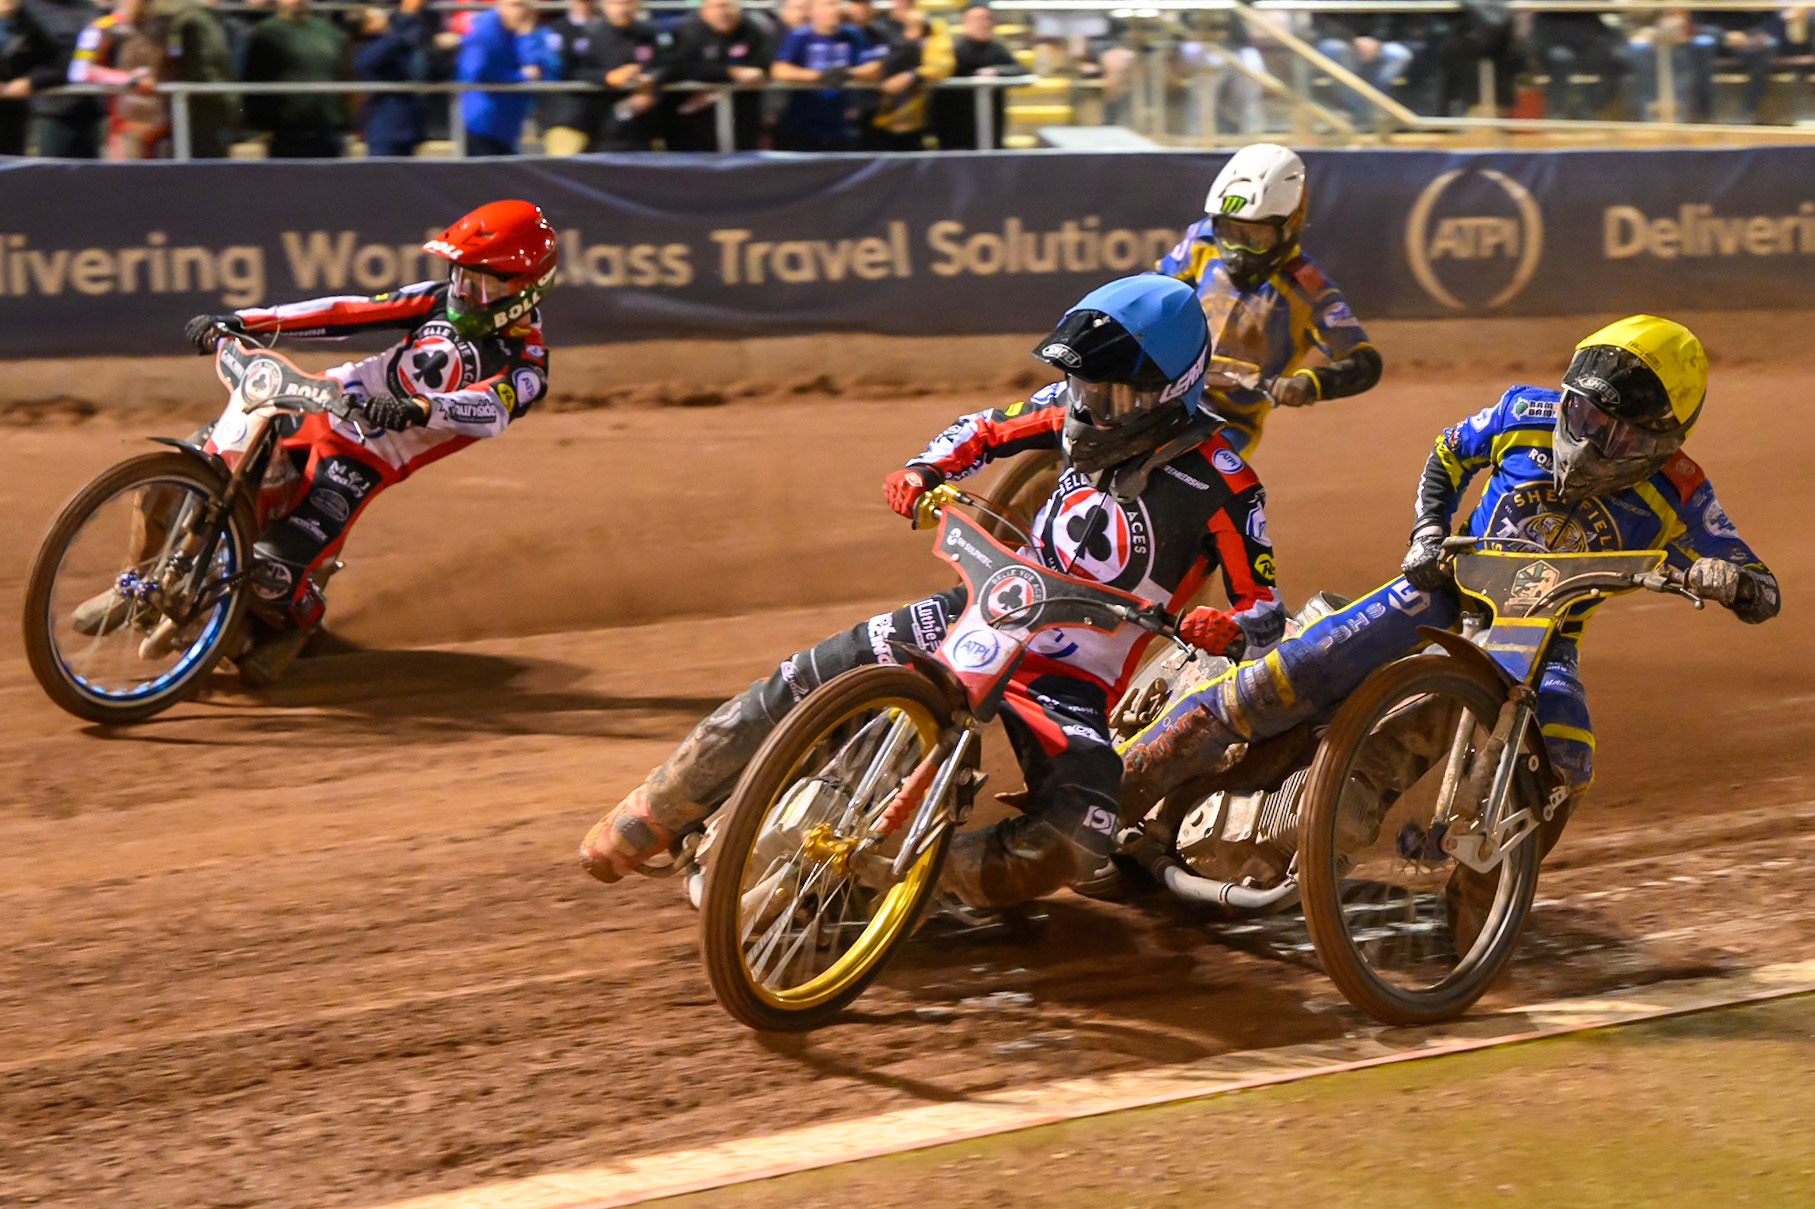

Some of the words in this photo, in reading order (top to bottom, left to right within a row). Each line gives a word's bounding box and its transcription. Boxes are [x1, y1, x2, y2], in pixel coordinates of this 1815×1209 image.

[280, 227, 447, 291] Worl
[557, 228, 692, 288] lass
[711, 221, 907, 285] Travel
[928, 214, 1184, 278] Solution
[1429, 216, 1520, 260] ATPI
[1583, 379, 1618, 402] SHOEI
[1219, 452, 1238, 467] ATPI
[1127, 511, 1148, 555] ACES
[1514, 489, 1614, 551] SHEFIEL
[1019, 570, 1036, 582] VUE
[1032, 583, 1042, 602] ACE
[960, 640, 991, 658] ATPI
